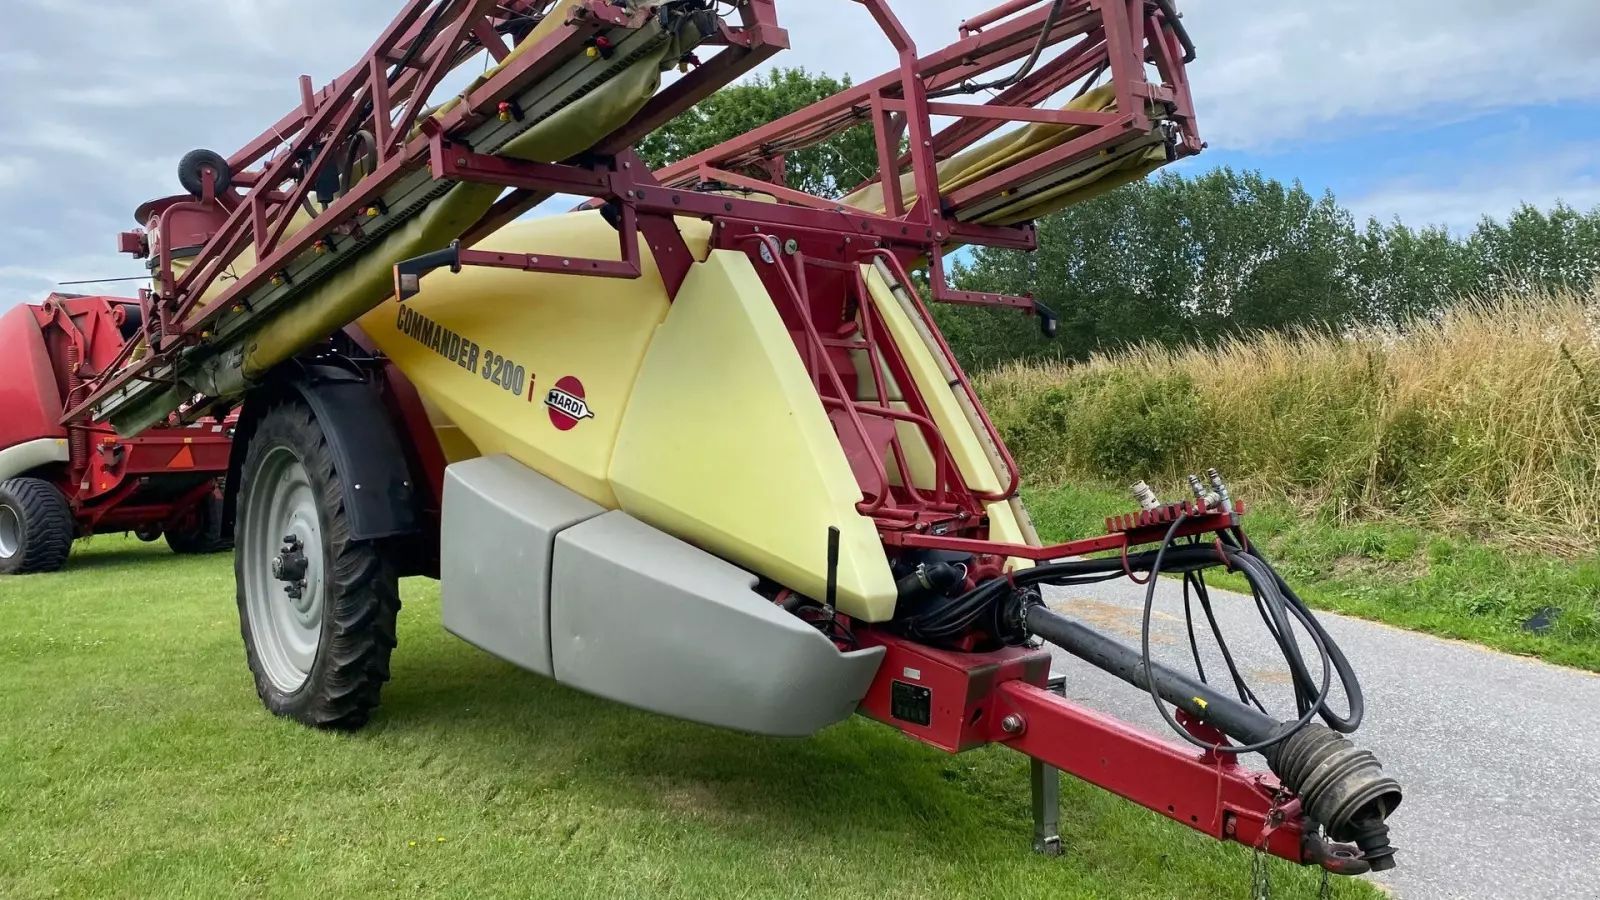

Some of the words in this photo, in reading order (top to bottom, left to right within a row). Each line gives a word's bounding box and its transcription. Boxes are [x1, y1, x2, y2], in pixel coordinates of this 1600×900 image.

[397, 304, 480, 374] COMMANDER
[482, 350, 526, 396] 3200
[528, 373, 536, 403] i
[549, 390, 584, 416] HARDI
